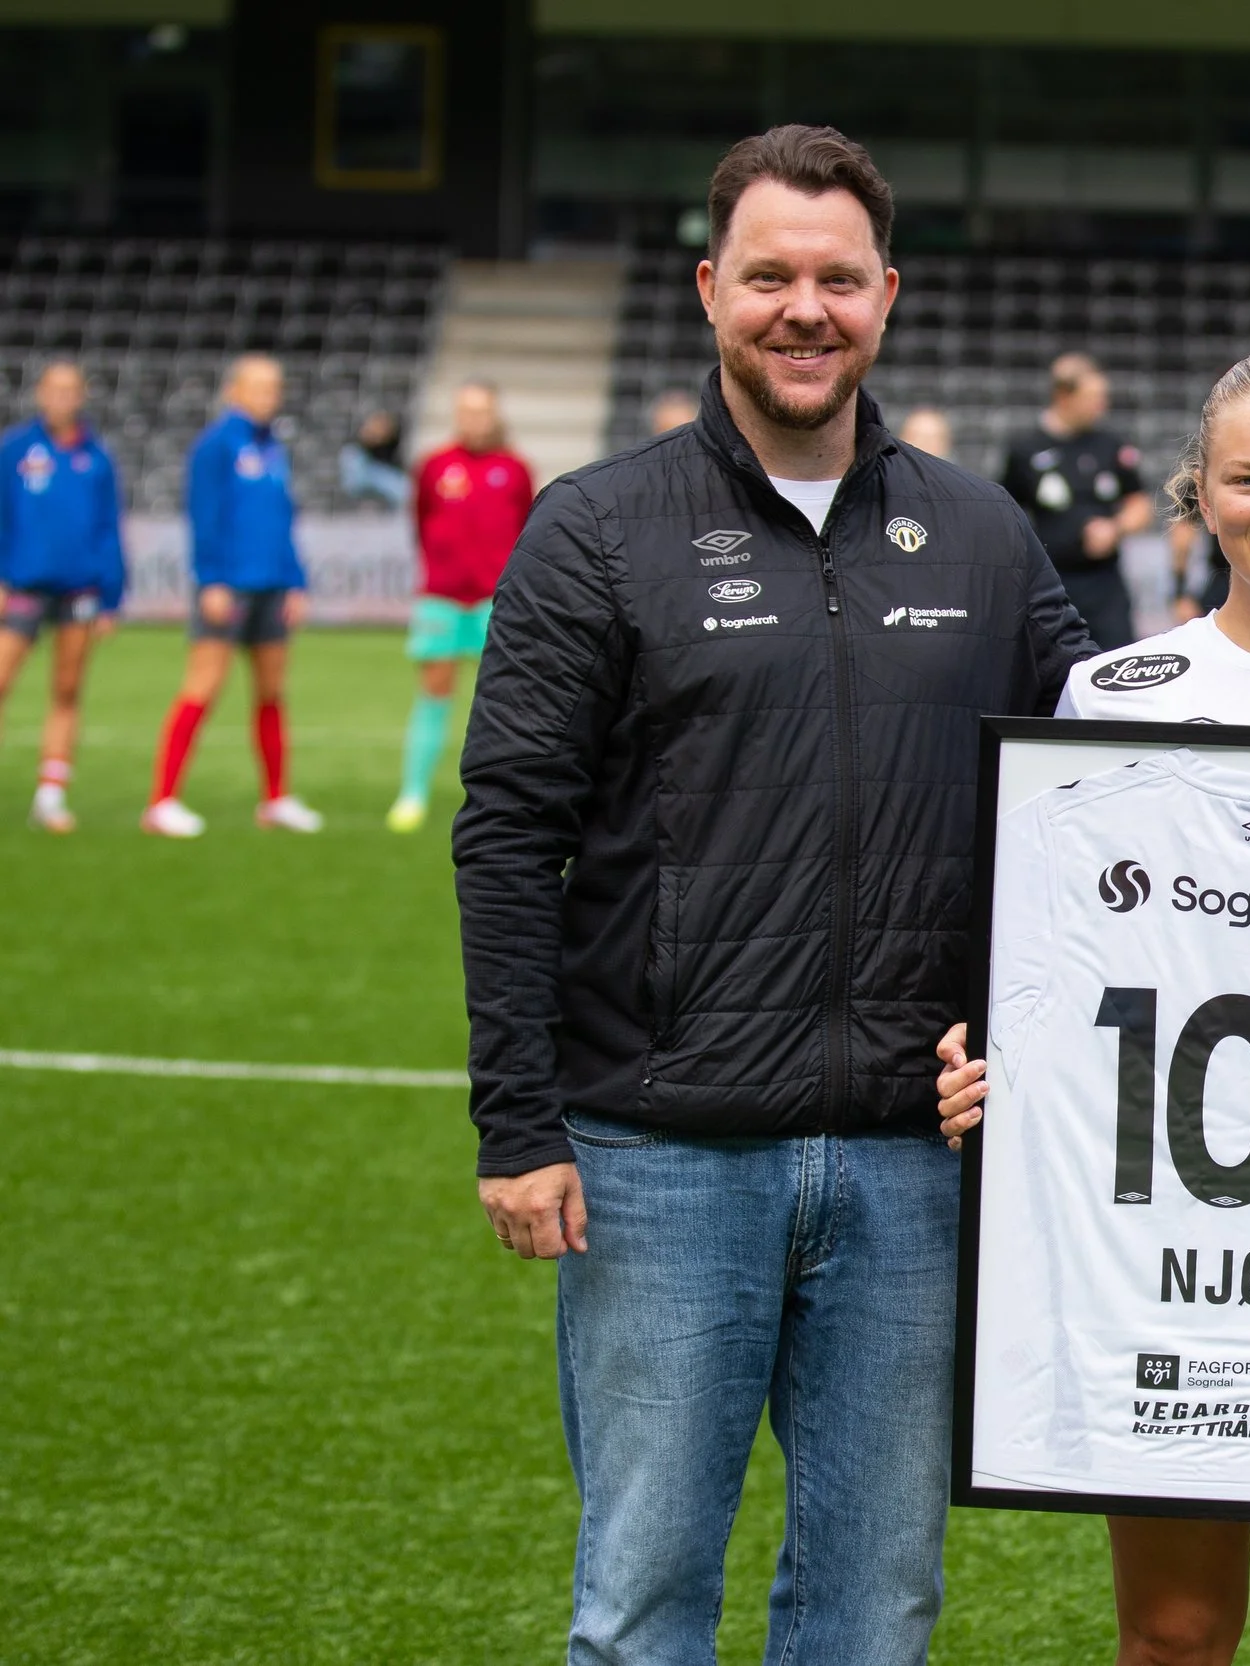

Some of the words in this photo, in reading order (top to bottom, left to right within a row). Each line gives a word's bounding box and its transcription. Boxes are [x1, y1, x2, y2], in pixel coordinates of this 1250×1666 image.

[889, 520, 922, 536] SOGNDAL
[700, 552, 752, 567] umbro
[712, 583, 755, 600] Lerum
[908, 607, 968, 619] Sparebanken
[720, 614, 779, 629] Sognekraft
[909, 617, 938, 628] Norge
[1096, 658, 1180, 687] Lerum
[1187, 1377, 1234, 1388] Sogndal
